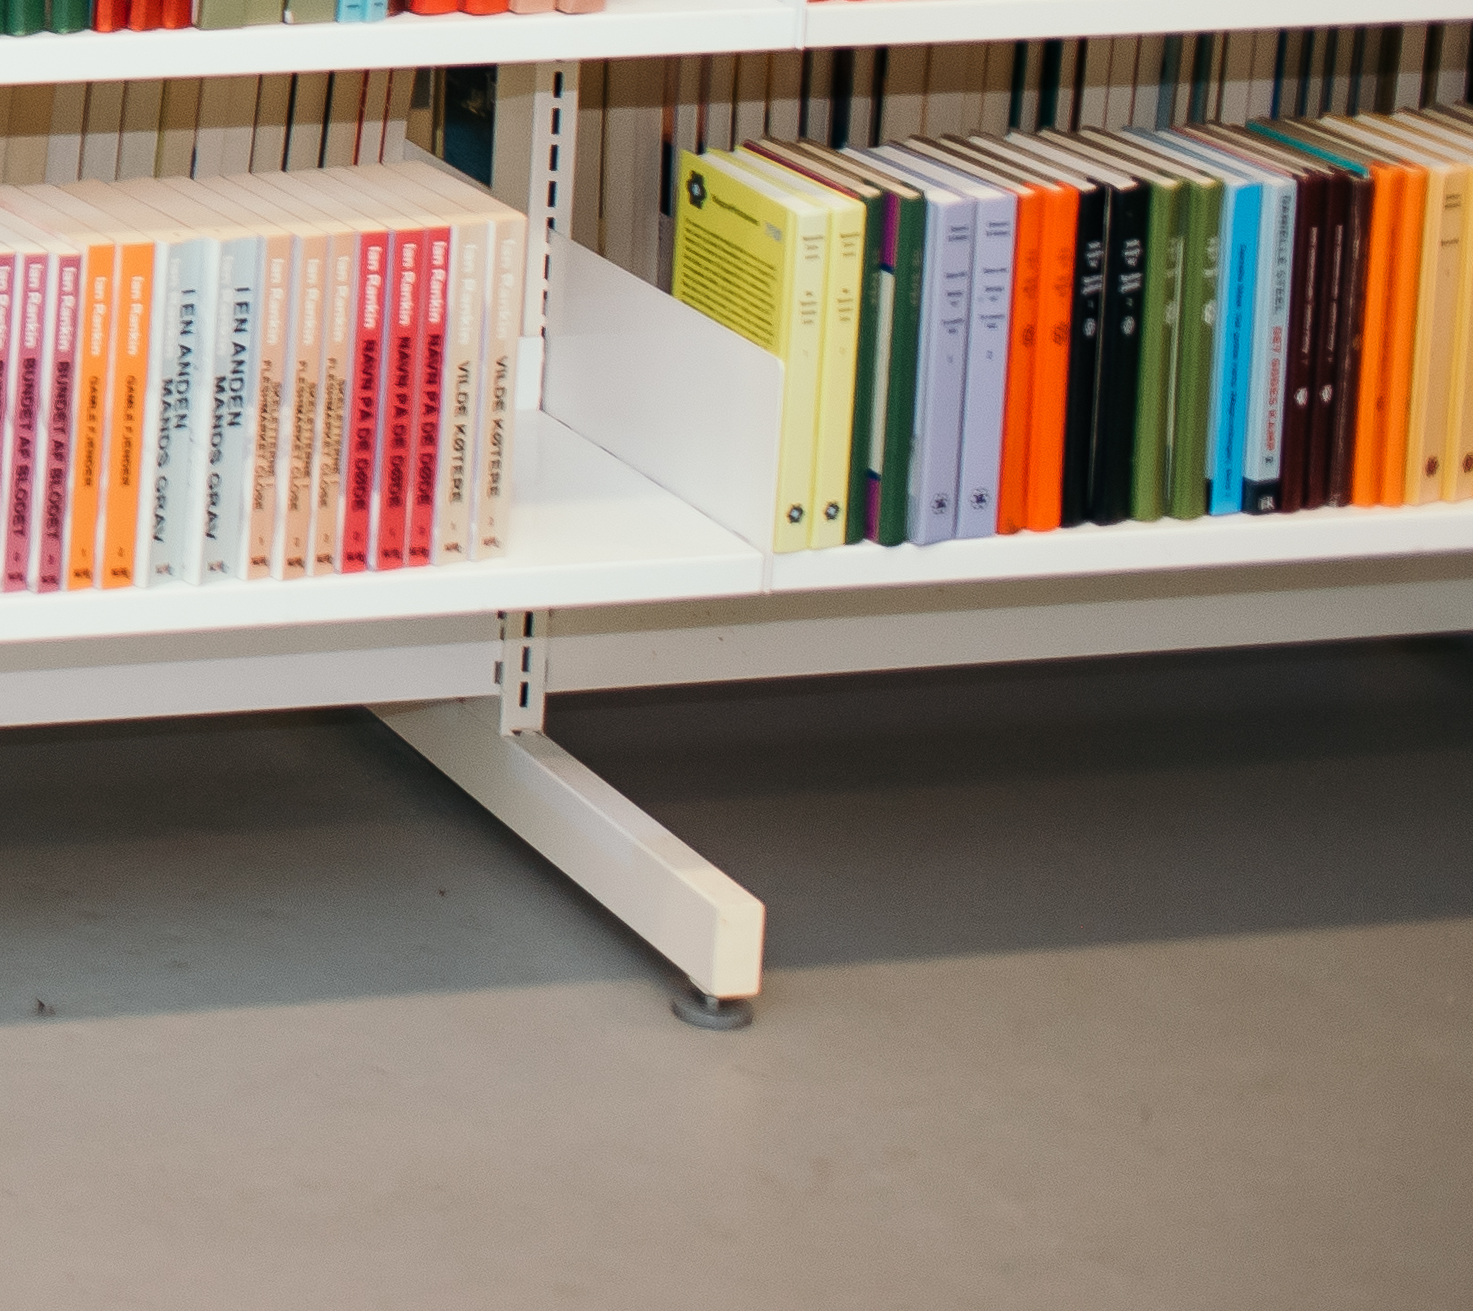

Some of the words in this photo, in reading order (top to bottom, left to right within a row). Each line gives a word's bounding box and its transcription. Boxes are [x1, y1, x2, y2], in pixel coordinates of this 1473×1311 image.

[232, 302, 250, 332] EN
[227, 341, 248, 427] ANDEN
[493, 356, 509, 412] VILDE
[209, 376, 227, 465] MANDS
